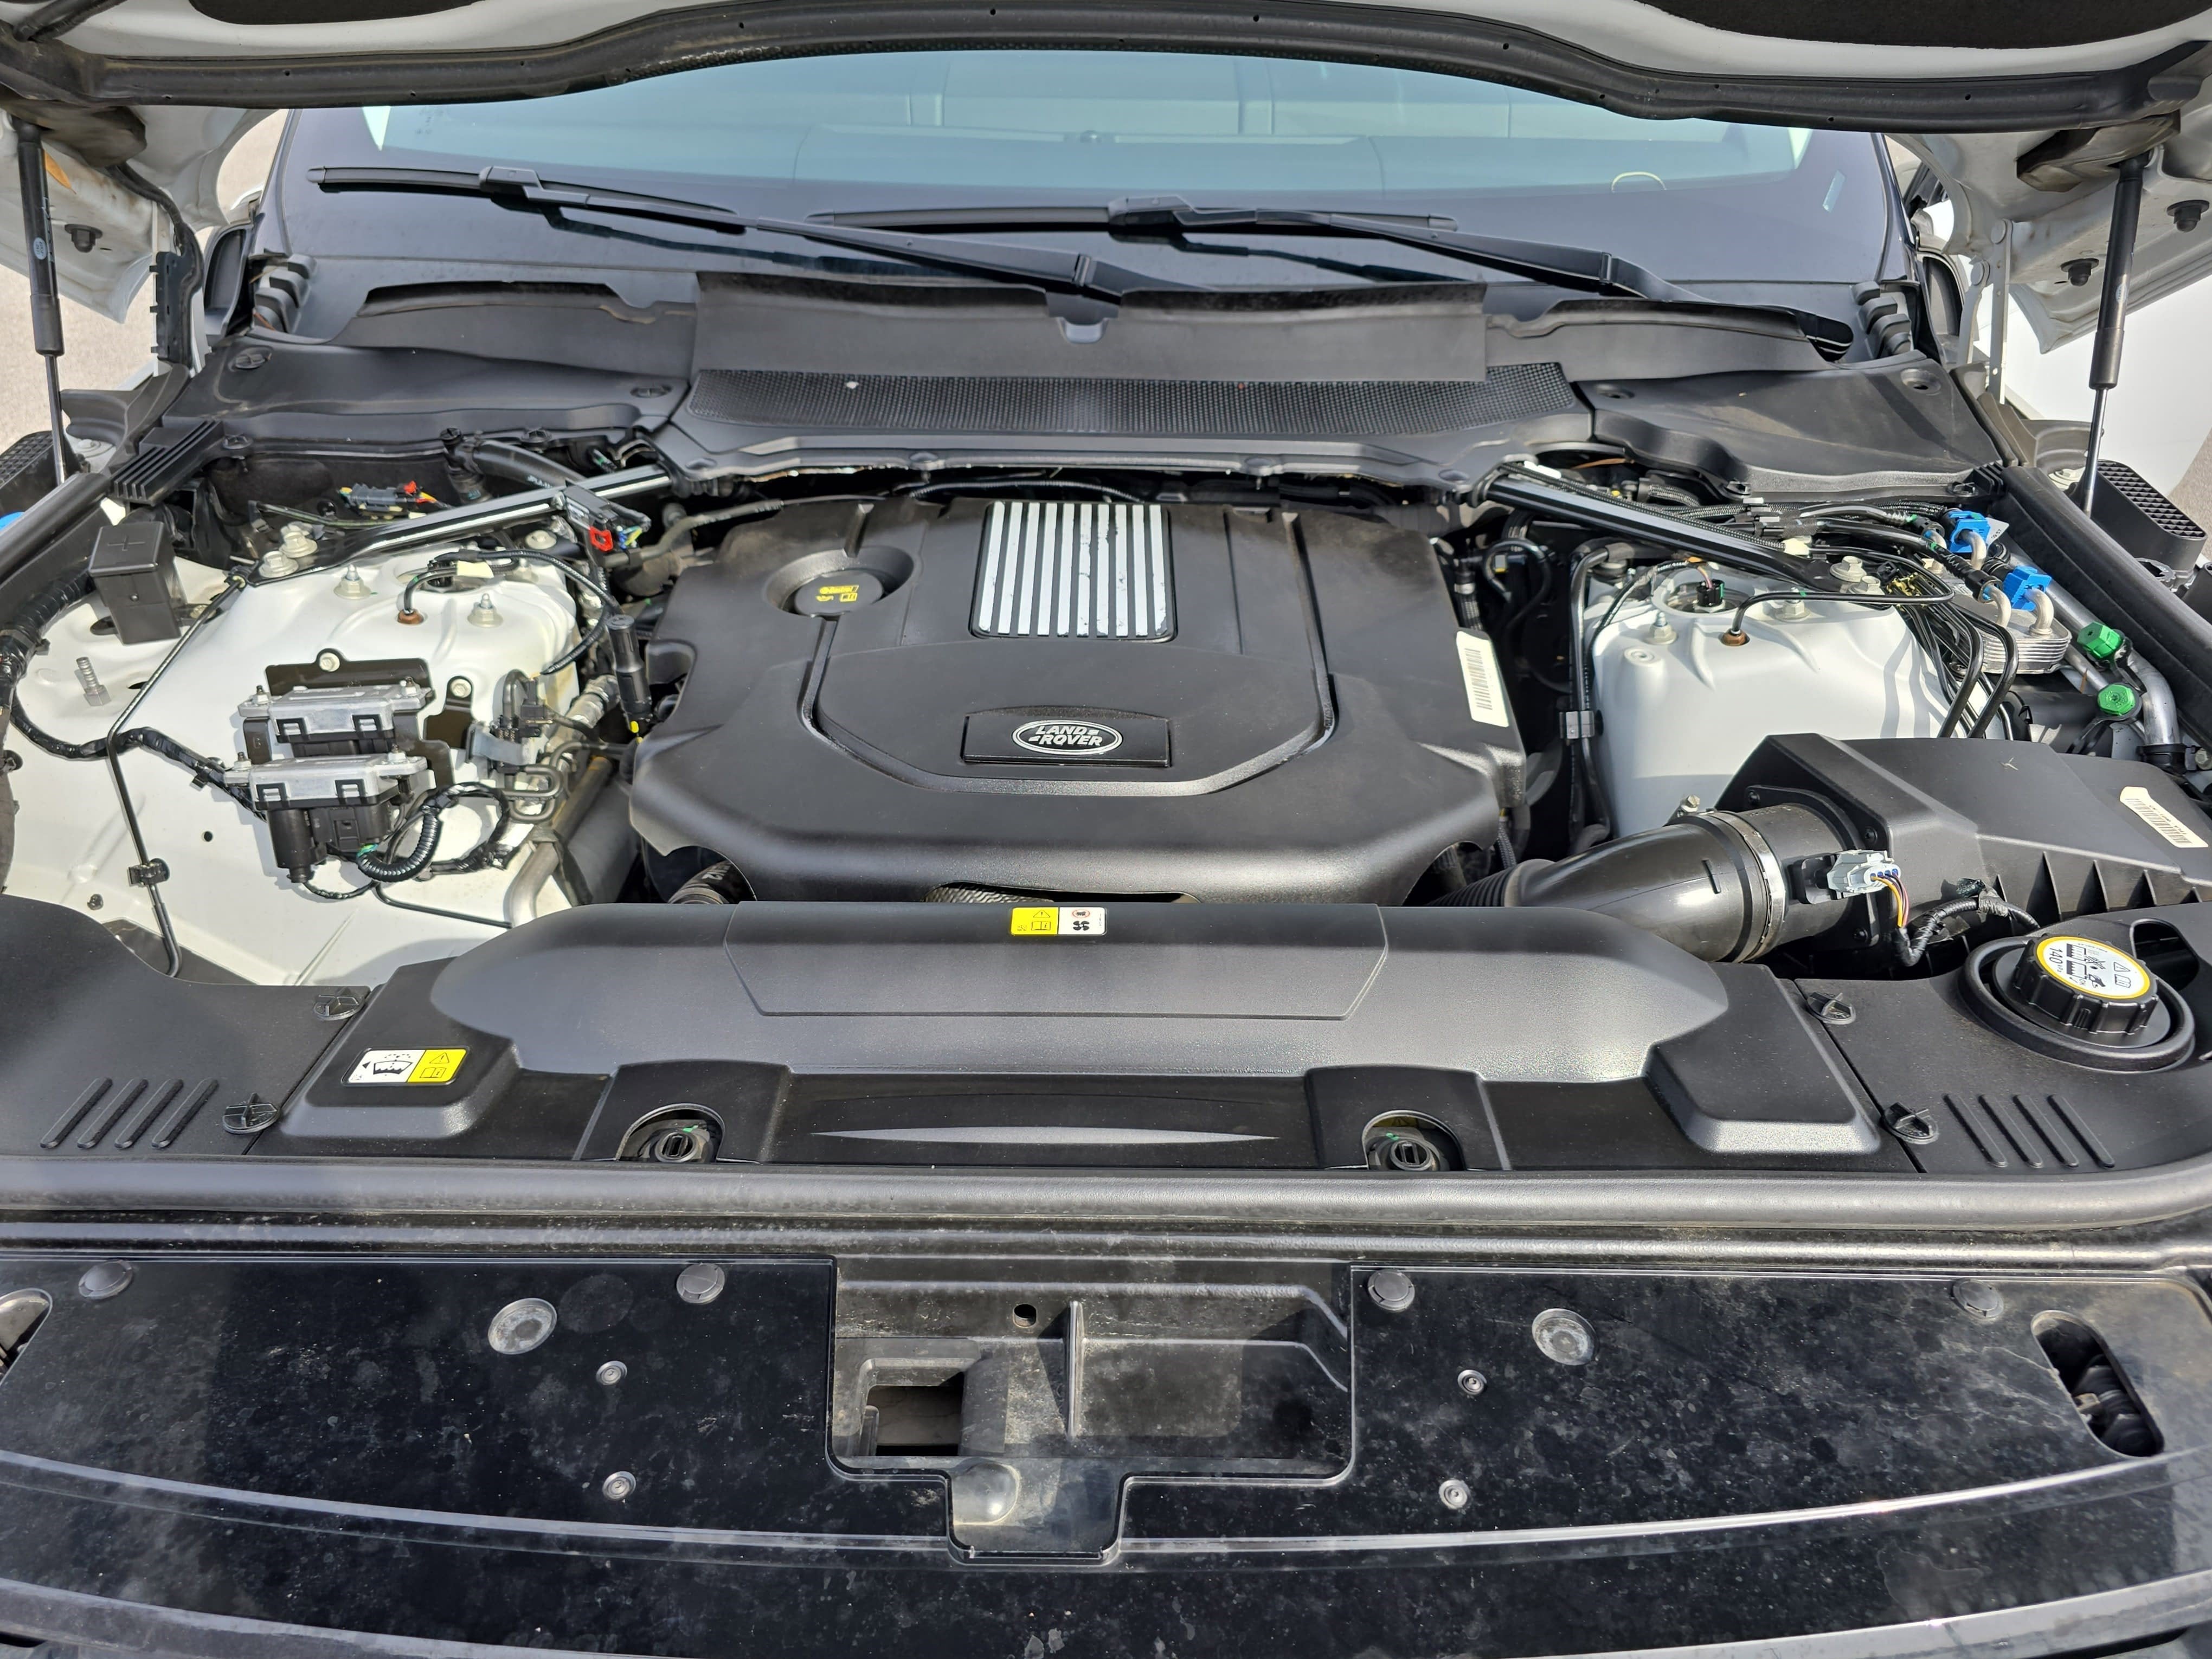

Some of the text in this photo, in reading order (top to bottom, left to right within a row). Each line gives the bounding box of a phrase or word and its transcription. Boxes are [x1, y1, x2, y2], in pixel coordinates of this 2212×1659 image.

[1036, 725, 1088, 735] LAND
[1038, 734, 1103, 747] ROVER
[2049, 948, 2063, 964] 140
